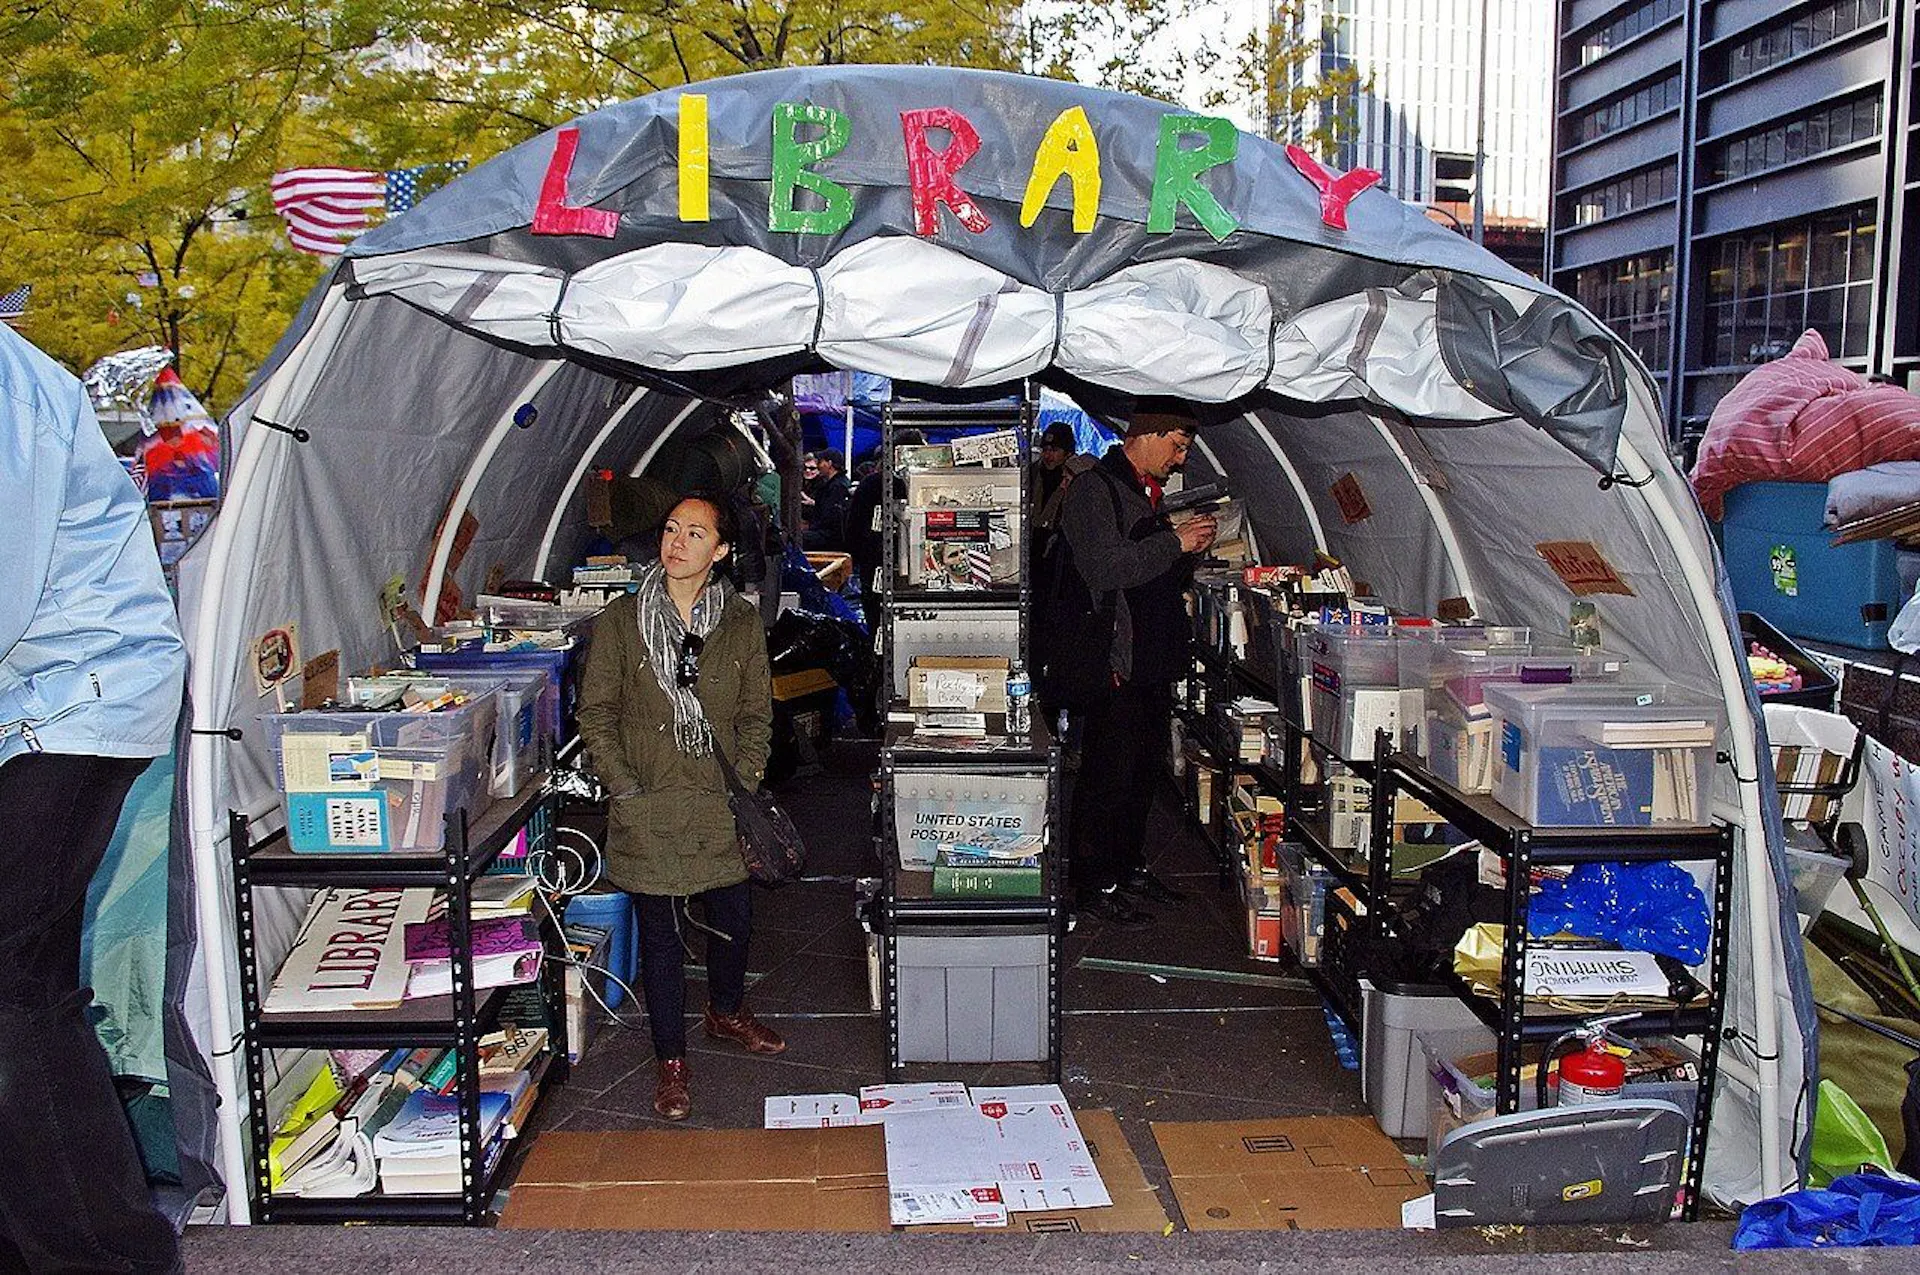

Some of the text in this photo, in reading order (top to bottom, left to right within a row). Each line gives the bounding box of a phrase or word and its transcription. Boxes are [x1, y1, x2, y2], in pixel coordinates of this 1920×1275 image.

[530, 94, 1383, 242] LIBRARY
[1543, 546, 1612, 580] History
[331, 805, 342, 838] LARK
[343, 801, 355, 842] OF THE
[357, 807, 366, 837] SONG
[368, 808, 379, 835] THE
[915, 812, 1022, 829] UNITED STATES
[1874, 779, 1890, 858] CAME
[1893, 788, 1907, 896] OCCUPY
[1530, 960, 1636, 977] SHIMMING
[1532, 975, 1581, 985] RADICAL
[1597, 973, 1639, 984] JOURNAL
